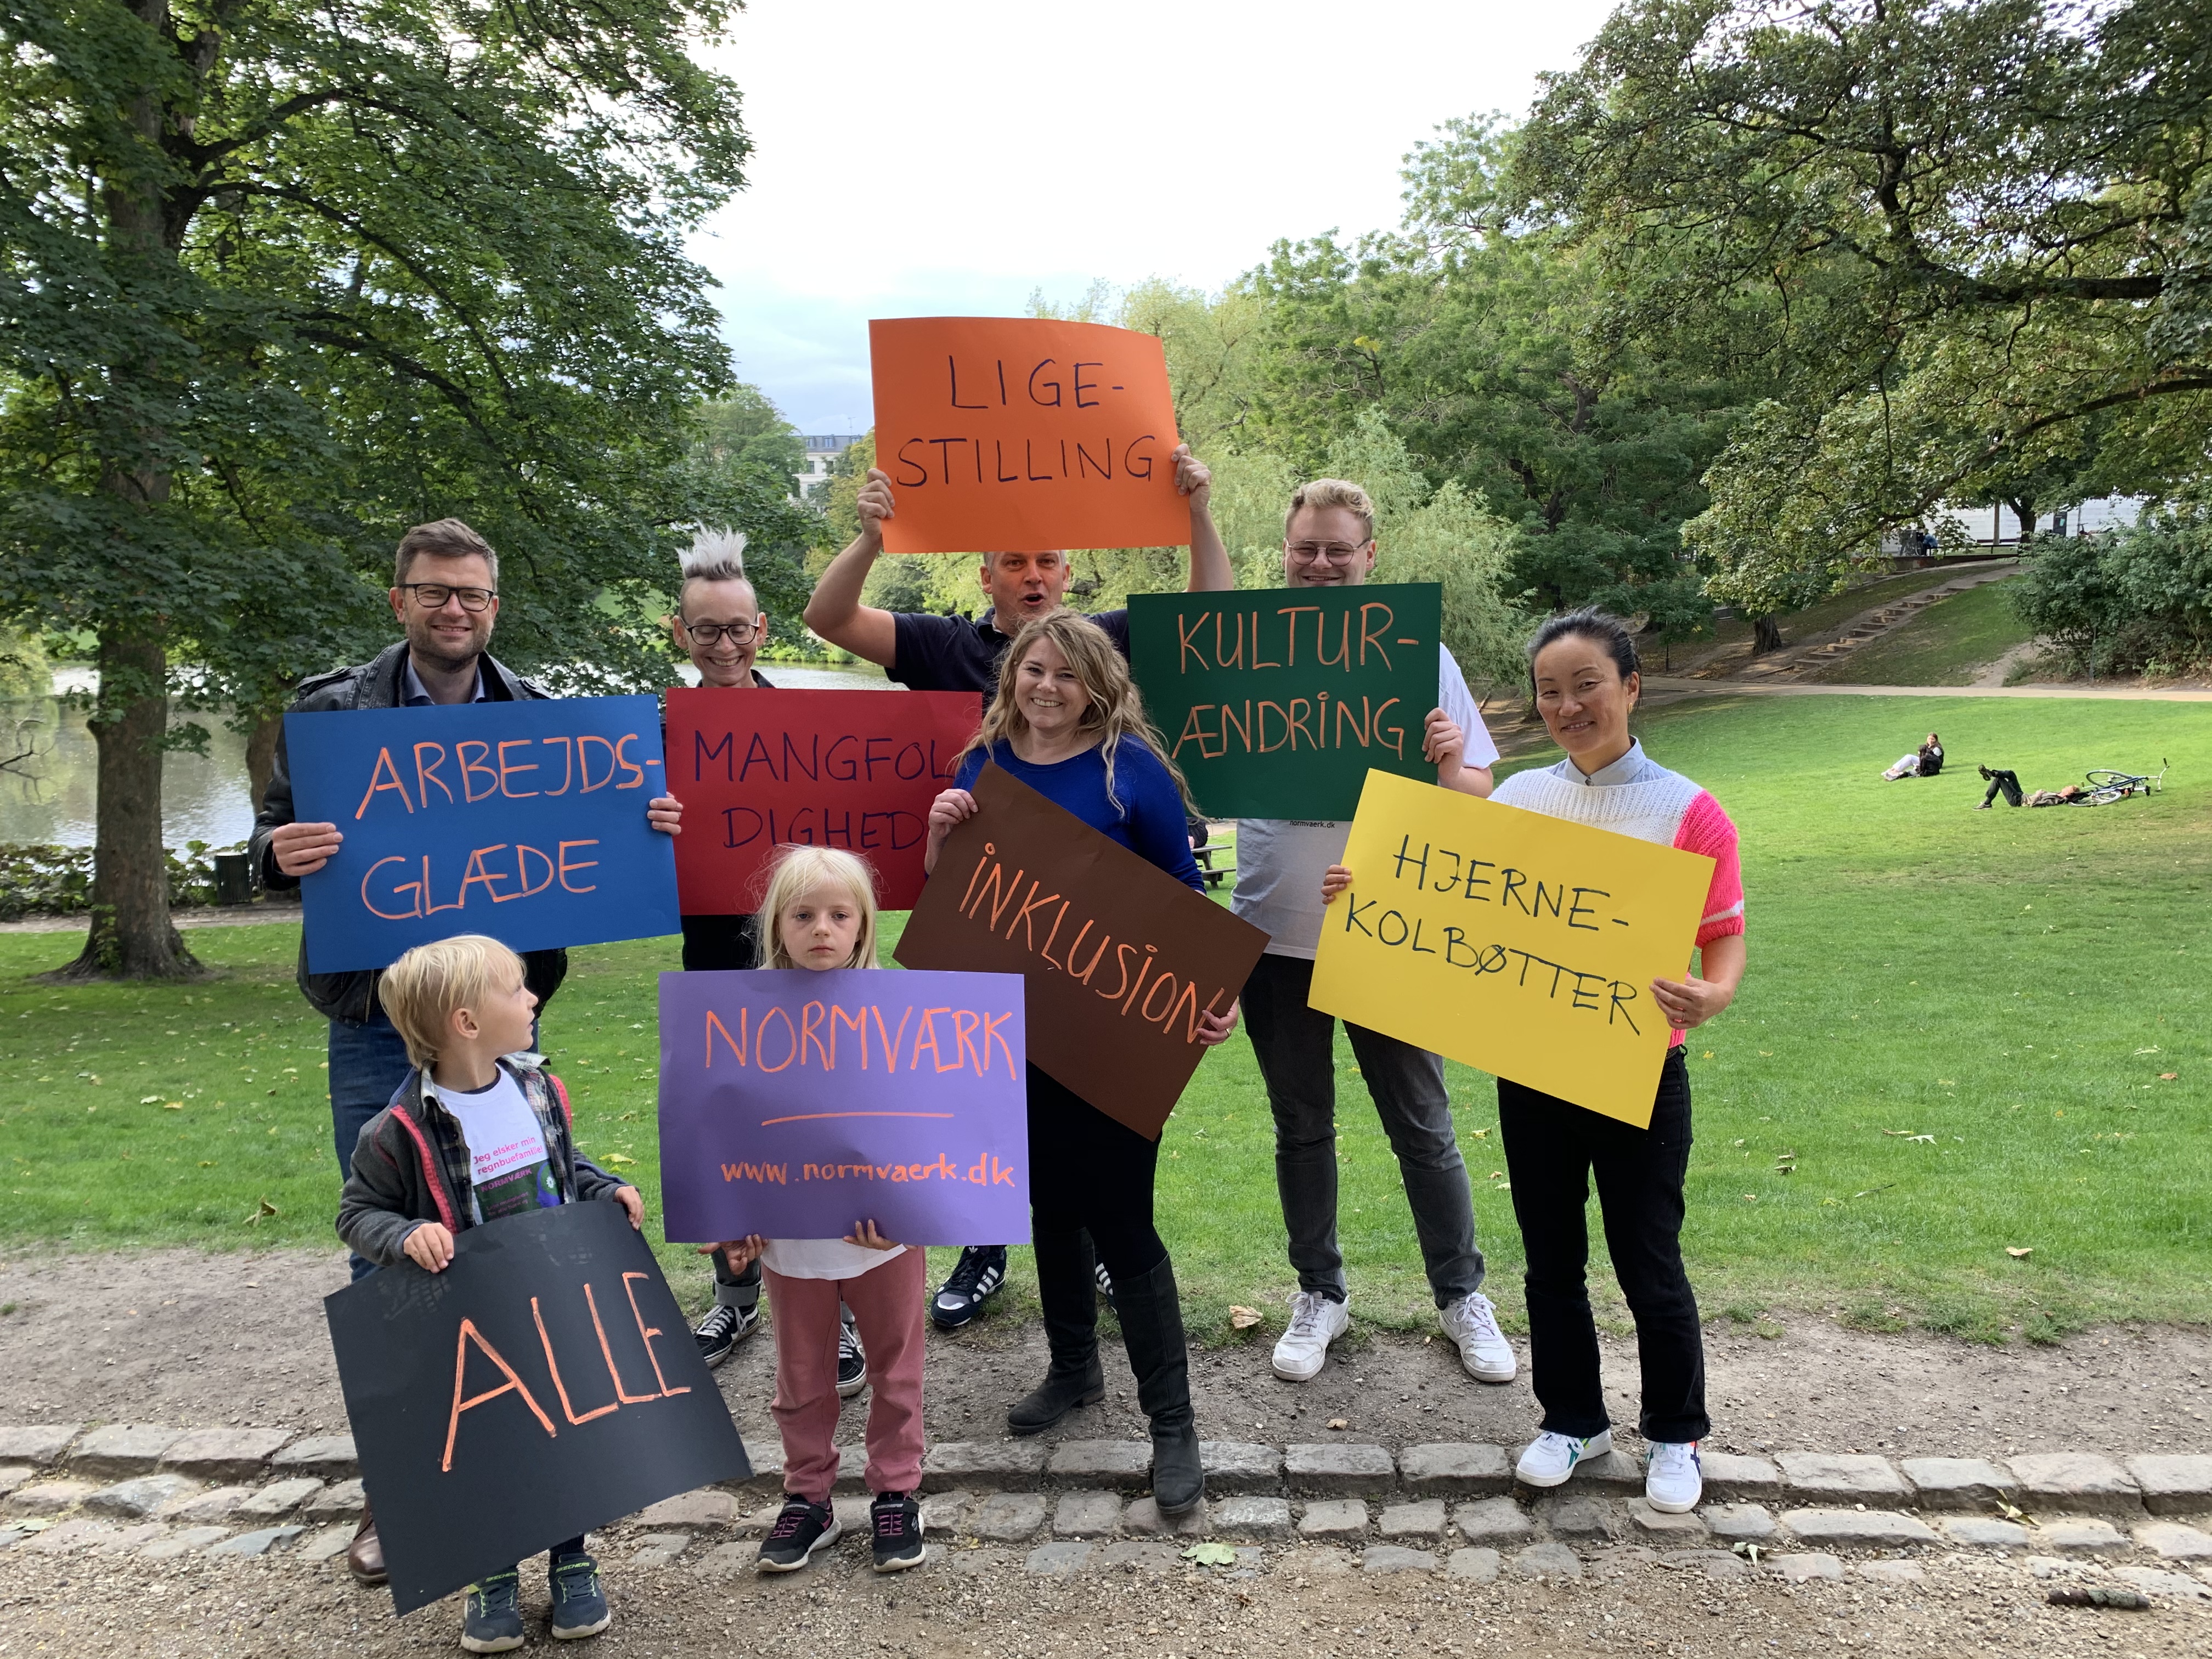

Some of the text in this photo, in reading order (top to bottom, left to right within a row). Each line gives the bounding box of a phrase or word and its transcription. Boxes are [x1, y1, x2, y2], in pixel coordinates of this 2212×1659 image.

[949, 355, 1124, 409] LIGE-
[896, 436, 1156, 487] STILLING
[1177, 602, 1419, 674] KULTUR-
[354, 733, 662, 820] ARBEJDS-
[721, 807, 925, 850] DIGHED
[360, 839, 600, 920] GLÆDE
[1392, 834, 1629, 932] HJERNE-
[1345, 892, 1640, 1036] KOLBØTTER
[706, 1000, 1017, 1080] NORMVÆRK
[473, 1137, 536, 1165] Jeg elsker min
[477, 1145, 543, 1175] regnbuefamilie!
[481, 1167, 532, 1193] NORMVÆRK
[720, 1153, 1015, 1187] www.normvaerk.dk
[441, 1272, 692, 1472] ALLE
